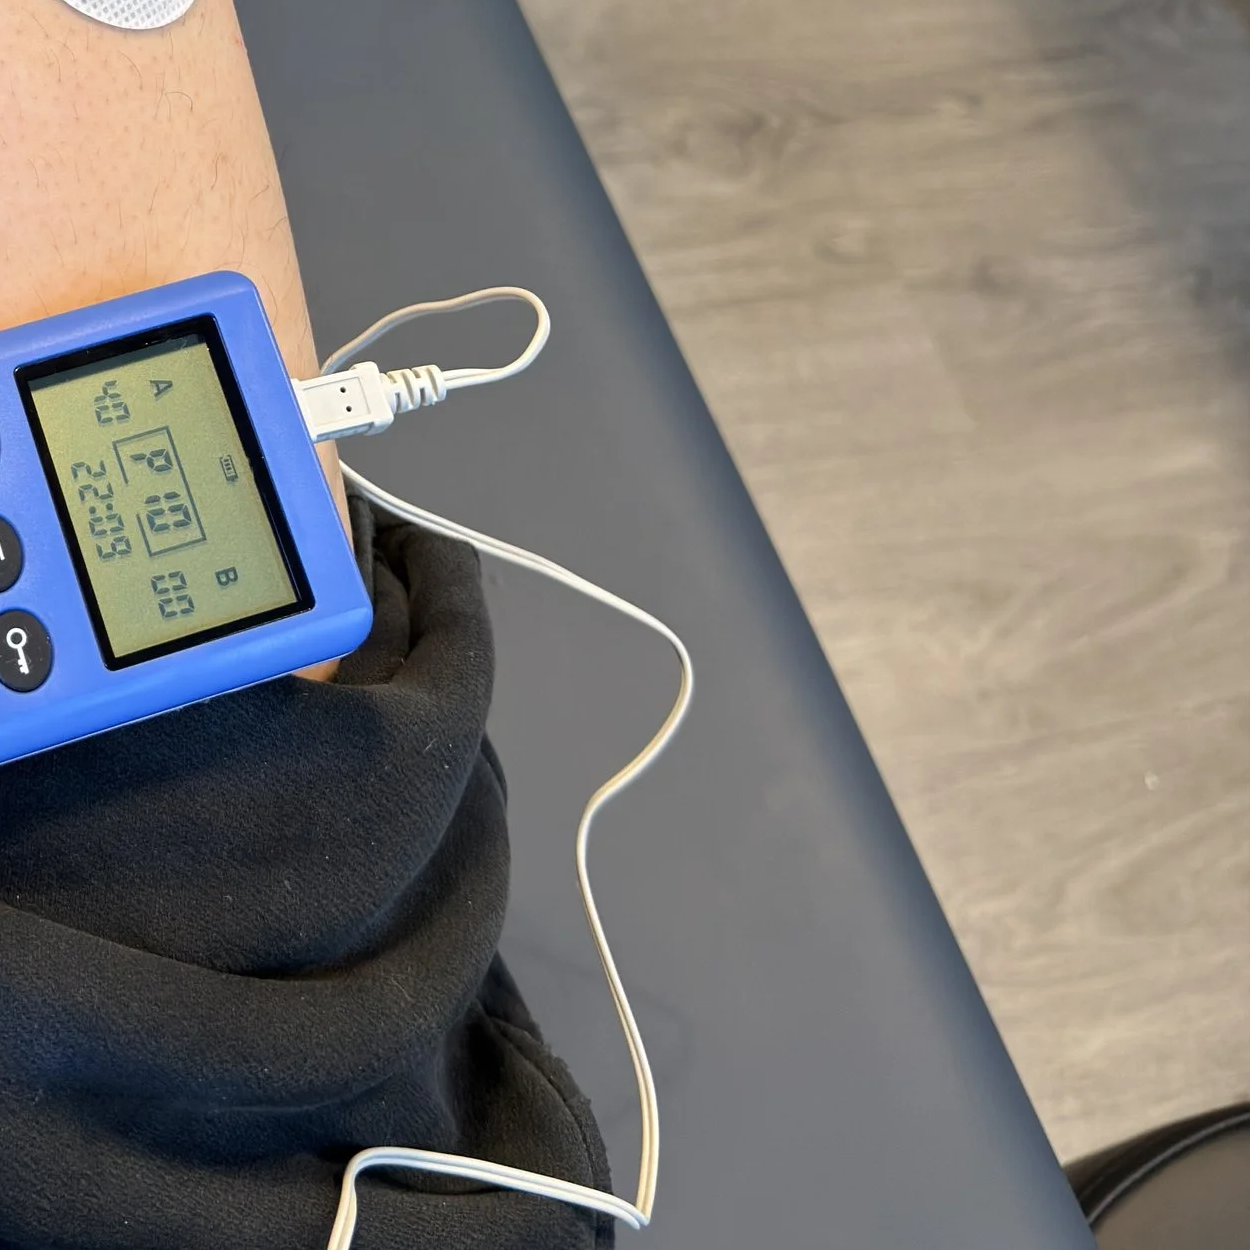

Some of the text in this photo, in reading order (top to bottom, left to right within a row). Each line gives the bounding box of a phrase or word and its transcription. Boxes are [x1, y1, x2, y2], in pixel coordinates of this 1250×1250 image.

[94, 380, 131, 424] 40
[150, 379, 173, 398] A
[71, 460, 132, 559] 22:09
[151, 570, 195, 618] 00
[215, 566, 238, 587] B
